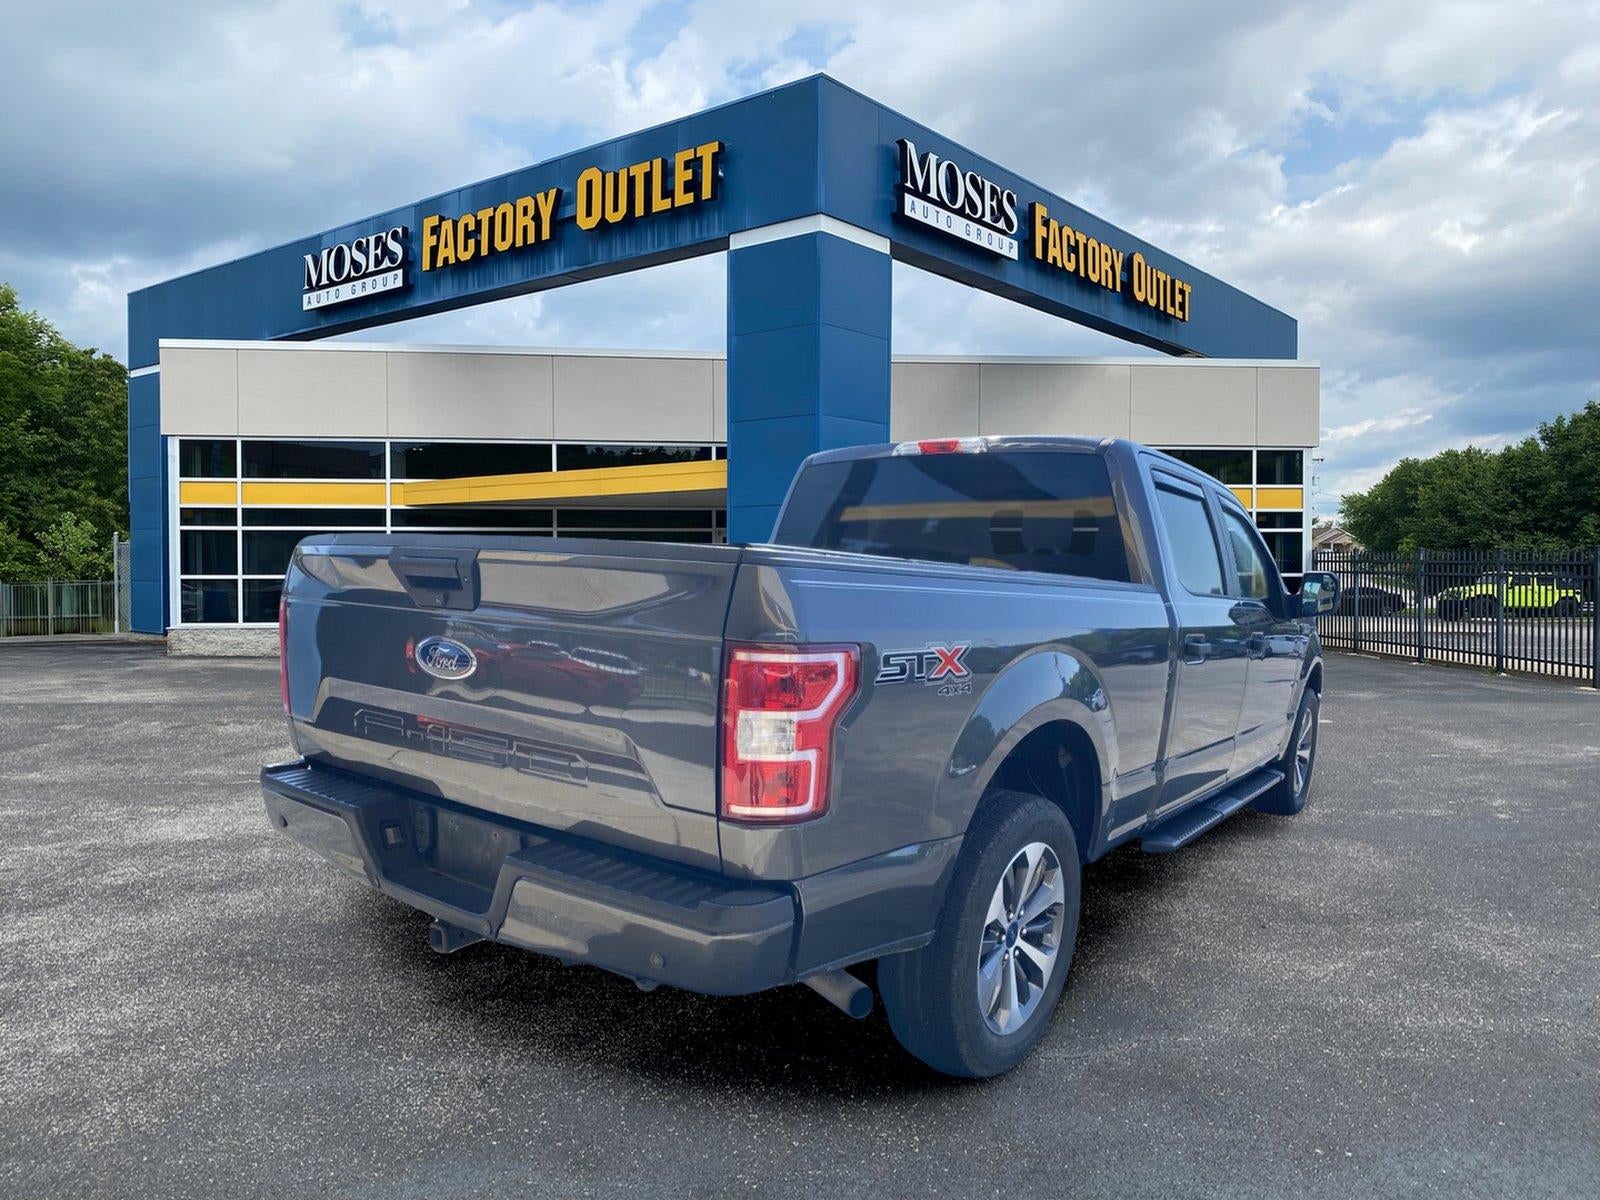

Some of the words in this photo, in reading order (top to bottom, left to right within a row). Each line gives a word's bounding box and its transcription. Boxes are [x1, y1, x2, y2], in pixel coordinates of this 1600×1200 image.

[422, 188, 559, 272] FACTORY
[576, 140, 720, 231] OUTLET
[904, 138, 1018, 234] MOSES
[303, 226, 404, 290] MOSES
[909, 200, 953, 229] AUTO
[965, 223, 1014, 254] GROUP
[307, 291, 341, 306] AUTO
[350, 273, 399, 295] GROUP
[1034, 202, 1124, 292] FACTORY
[1131, 252, 1191, 321] OUTLET
[426, 646, 461, 672] Ford
[875, 645, 969, 685] STX
[353, 708, 590, 788] F-150
